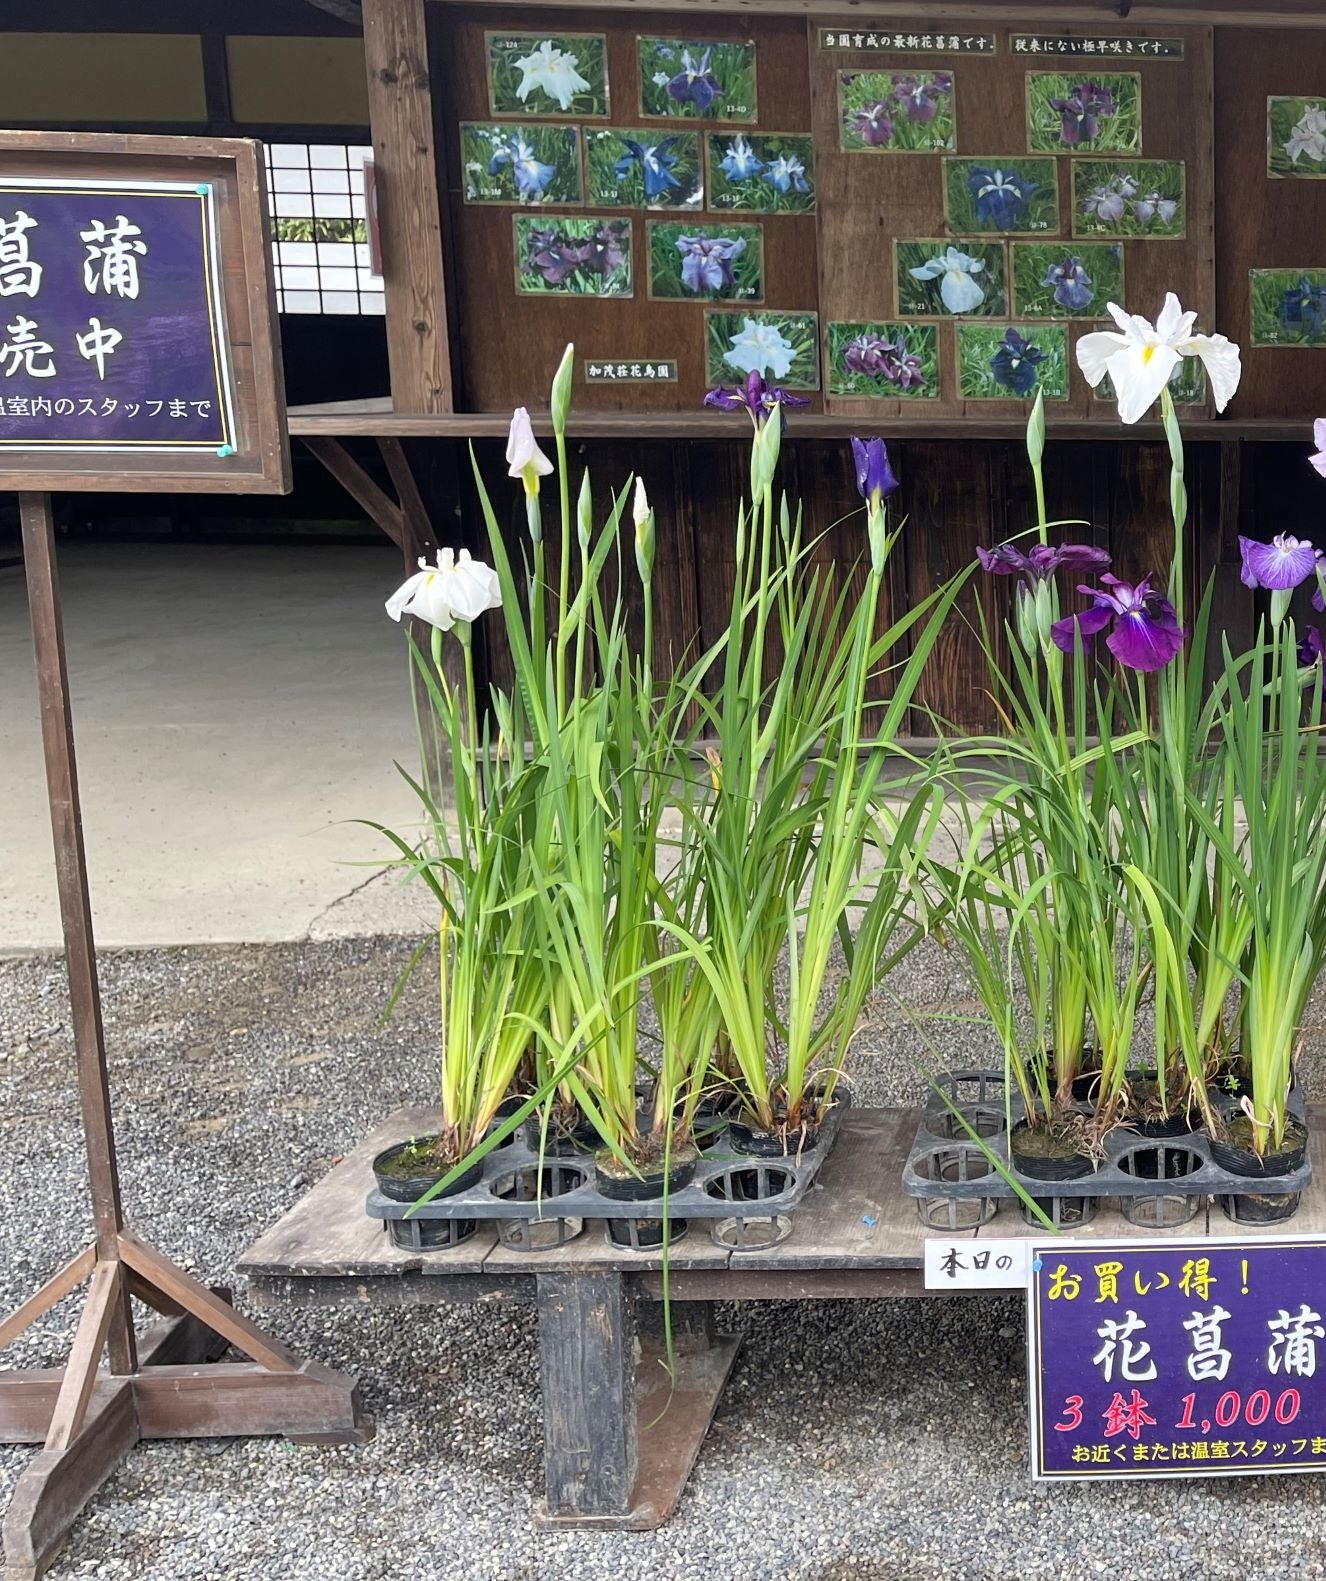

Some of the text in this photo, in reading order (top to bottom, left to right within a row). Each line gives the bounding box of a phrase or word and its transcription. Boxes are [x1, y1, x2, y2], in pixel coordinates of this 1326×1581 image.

[940, 1247, 1014, 1278] 本日の
[1092, 1304, 1326, 1383] 花菖蒲
